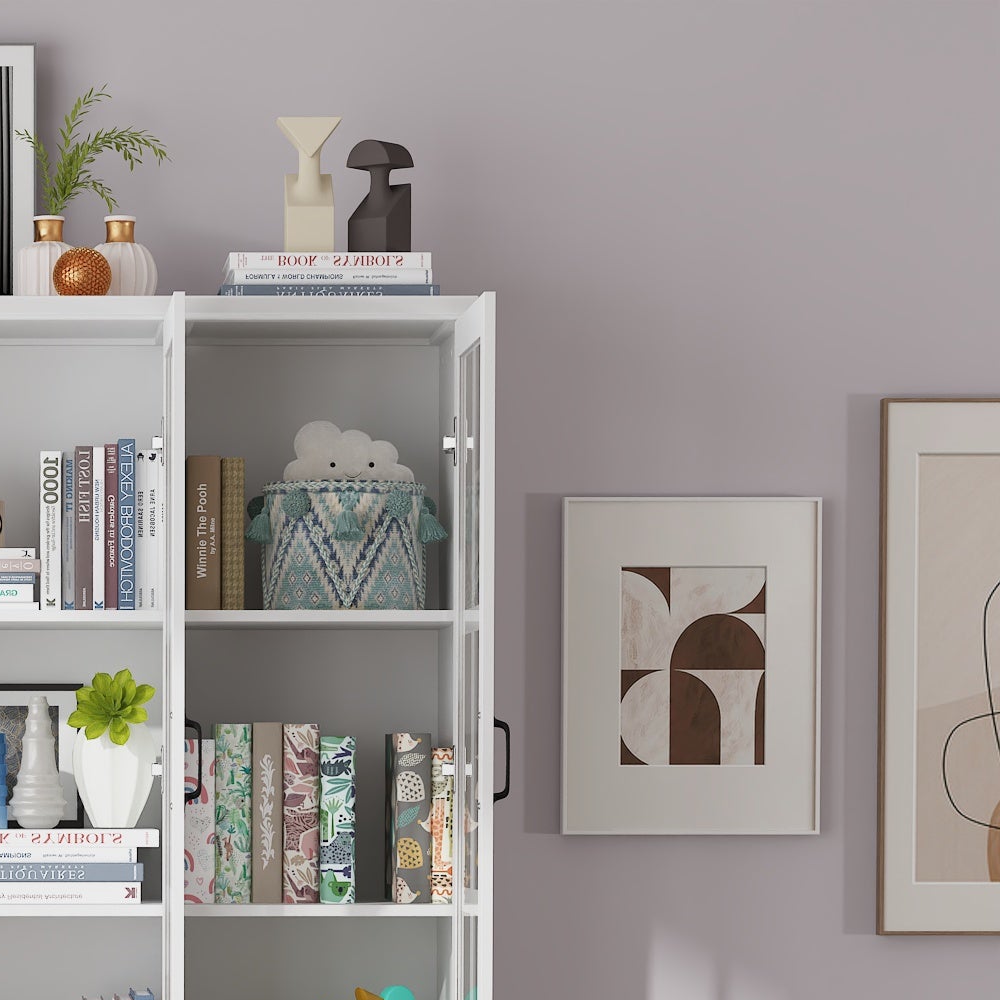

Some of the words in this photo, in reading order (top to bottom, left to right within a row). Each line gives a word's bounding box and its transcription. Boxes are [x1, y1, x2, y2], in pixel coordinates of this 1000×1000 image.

[197, 484, 207, 512] Pooh
[197, 516, 207, 536] The
[197, 540, 206, 578] Winnie
